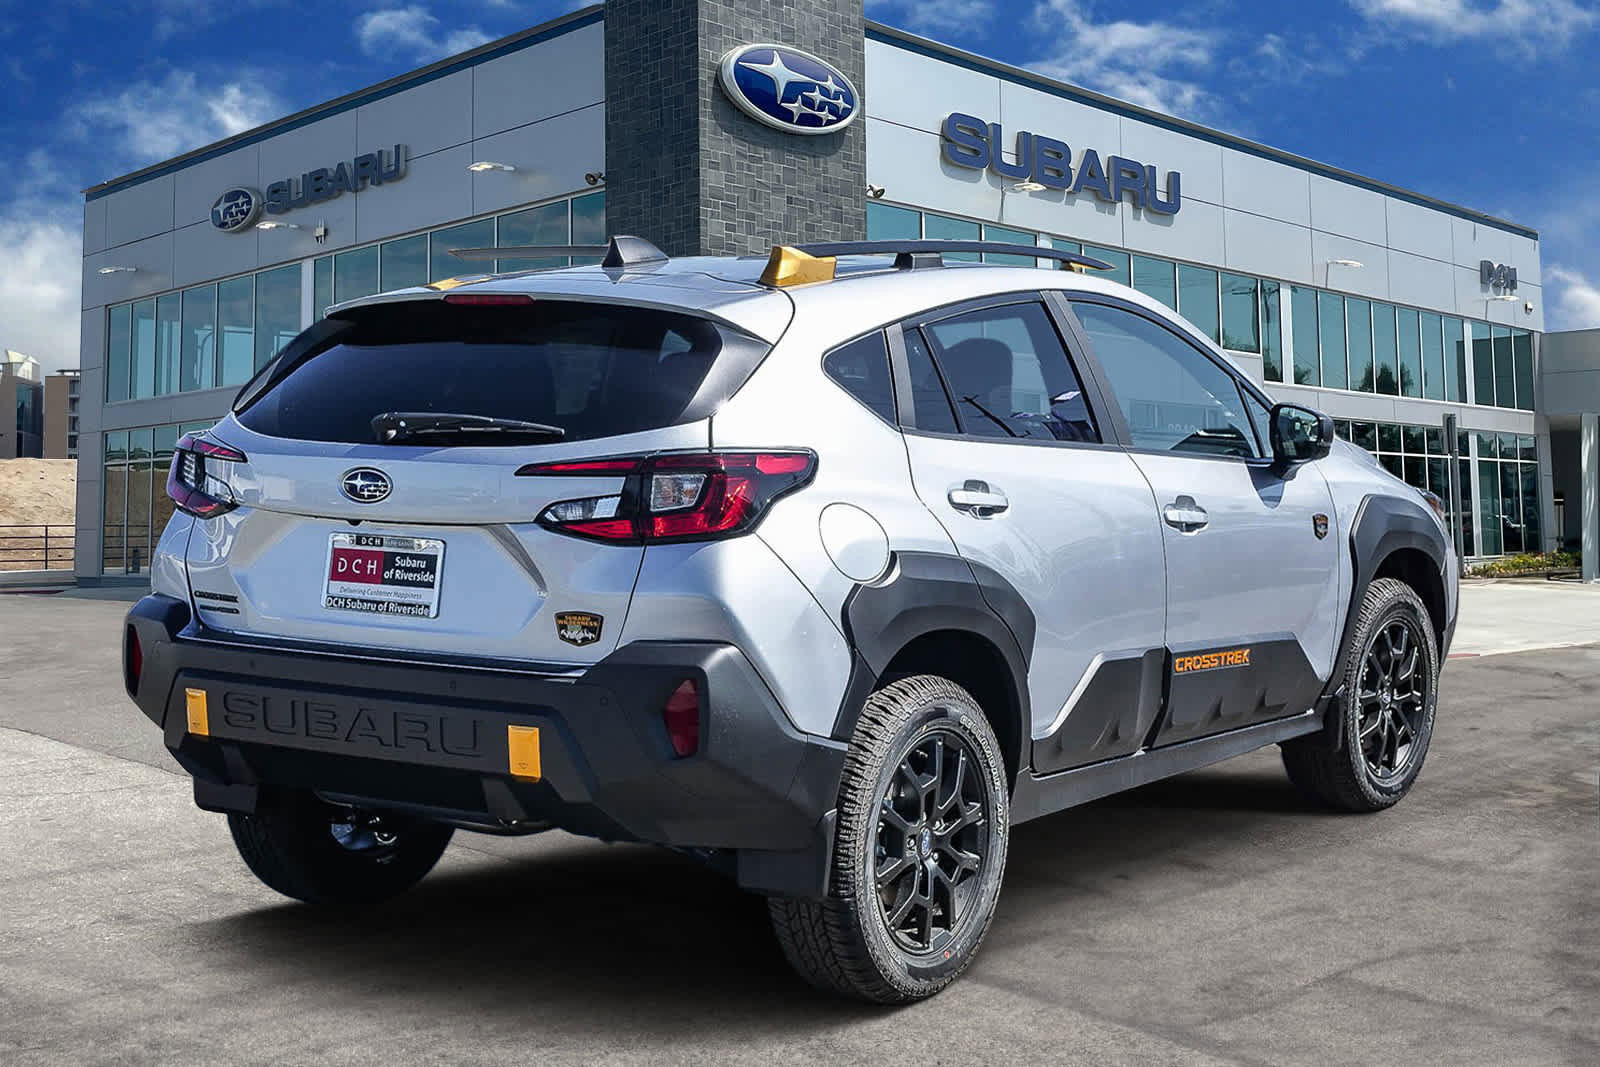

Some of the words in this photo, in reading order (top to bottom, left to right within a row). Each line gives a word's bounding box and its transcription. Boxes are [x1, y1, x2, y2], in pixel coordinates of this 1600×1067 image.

[942, 111, 1181, 216] SUBARU
[266, 144, 407, 215] SUBARU
[337, 557, 378, 576] DCH
[394, 556, 427, 569] Subaru
[383, 568, 395, 580] of
[394, 569, 435, 583] Riverside
[326, 596, 345, 609] DCH
[346, 598, 377, 611] Subaru
[377, 601, 388, 612] of
[388, 602, 429, 616] Riverside
[1175, 648, 1251, 673] CROSSTREK
[222, 690, 482, 759] SUBARU
